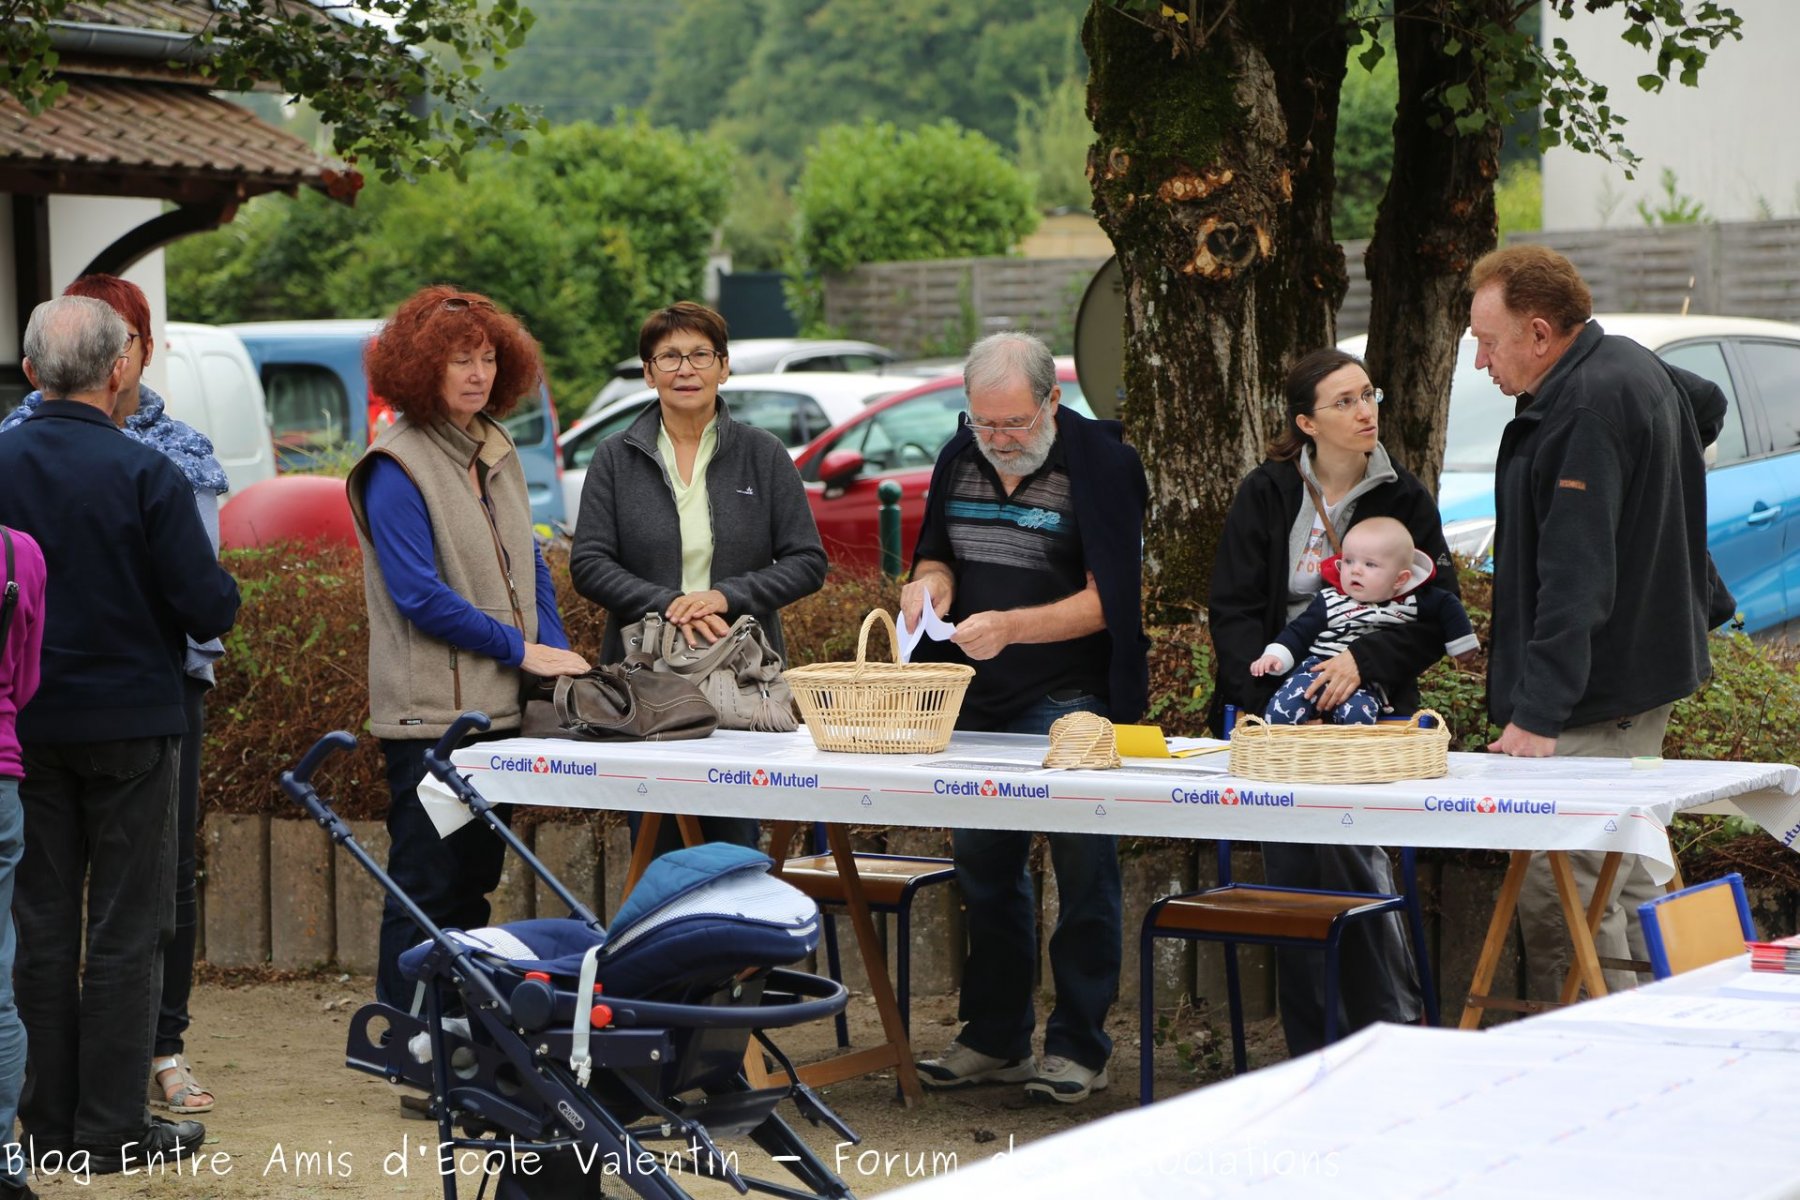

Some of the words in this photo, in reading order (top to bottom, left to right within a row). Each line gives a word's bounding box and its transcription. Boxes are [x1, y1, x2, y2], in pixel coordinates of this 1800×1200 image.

[490, 755, 533, 774] Crédit
[550, 759, 598, 777] Mutuel
[707, 767, 752, 787] Crédit
[769, 771, 819, 790] Mutuel
[933, 778, 980, 797] Crédit
[998, 782, 1050, 800] Mutuel
[1171, 786, 1219, 806] Crédit
[1239, 790, 1295, 808] Mutuel
[1423, 795, 1476, 814] Crédit
[1497, 798, 1557, 816] Mutuel
[1780, 823, 1800, 848] utu
